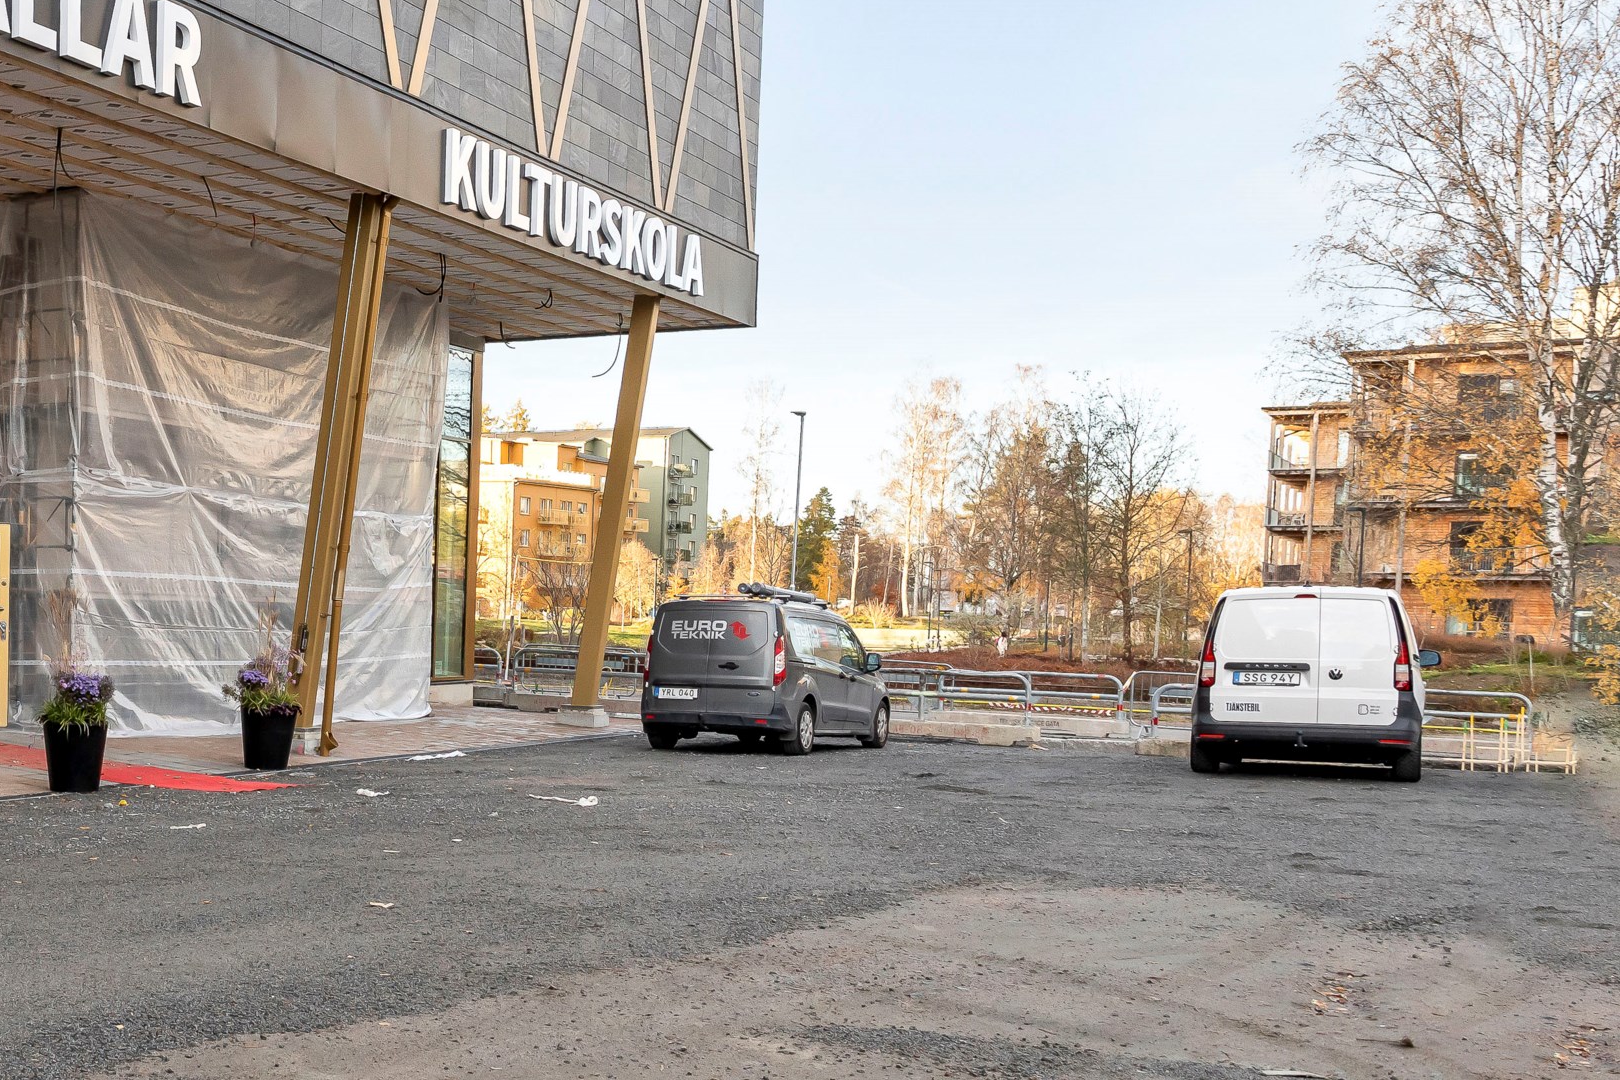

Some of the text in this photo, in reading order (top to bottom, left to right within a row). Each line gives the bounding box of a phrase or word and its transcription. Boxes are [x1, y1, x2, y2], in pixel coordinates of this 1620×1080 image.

[443, 127, 704, 297] KULTURSKOLA
[671, 620, 728, 631] EURO
[671, 631, 726, 640] TEKNIK
[1243, 673, 1295, 683] SSG 94Y
[661, 688, 695, 697] YRL 040
